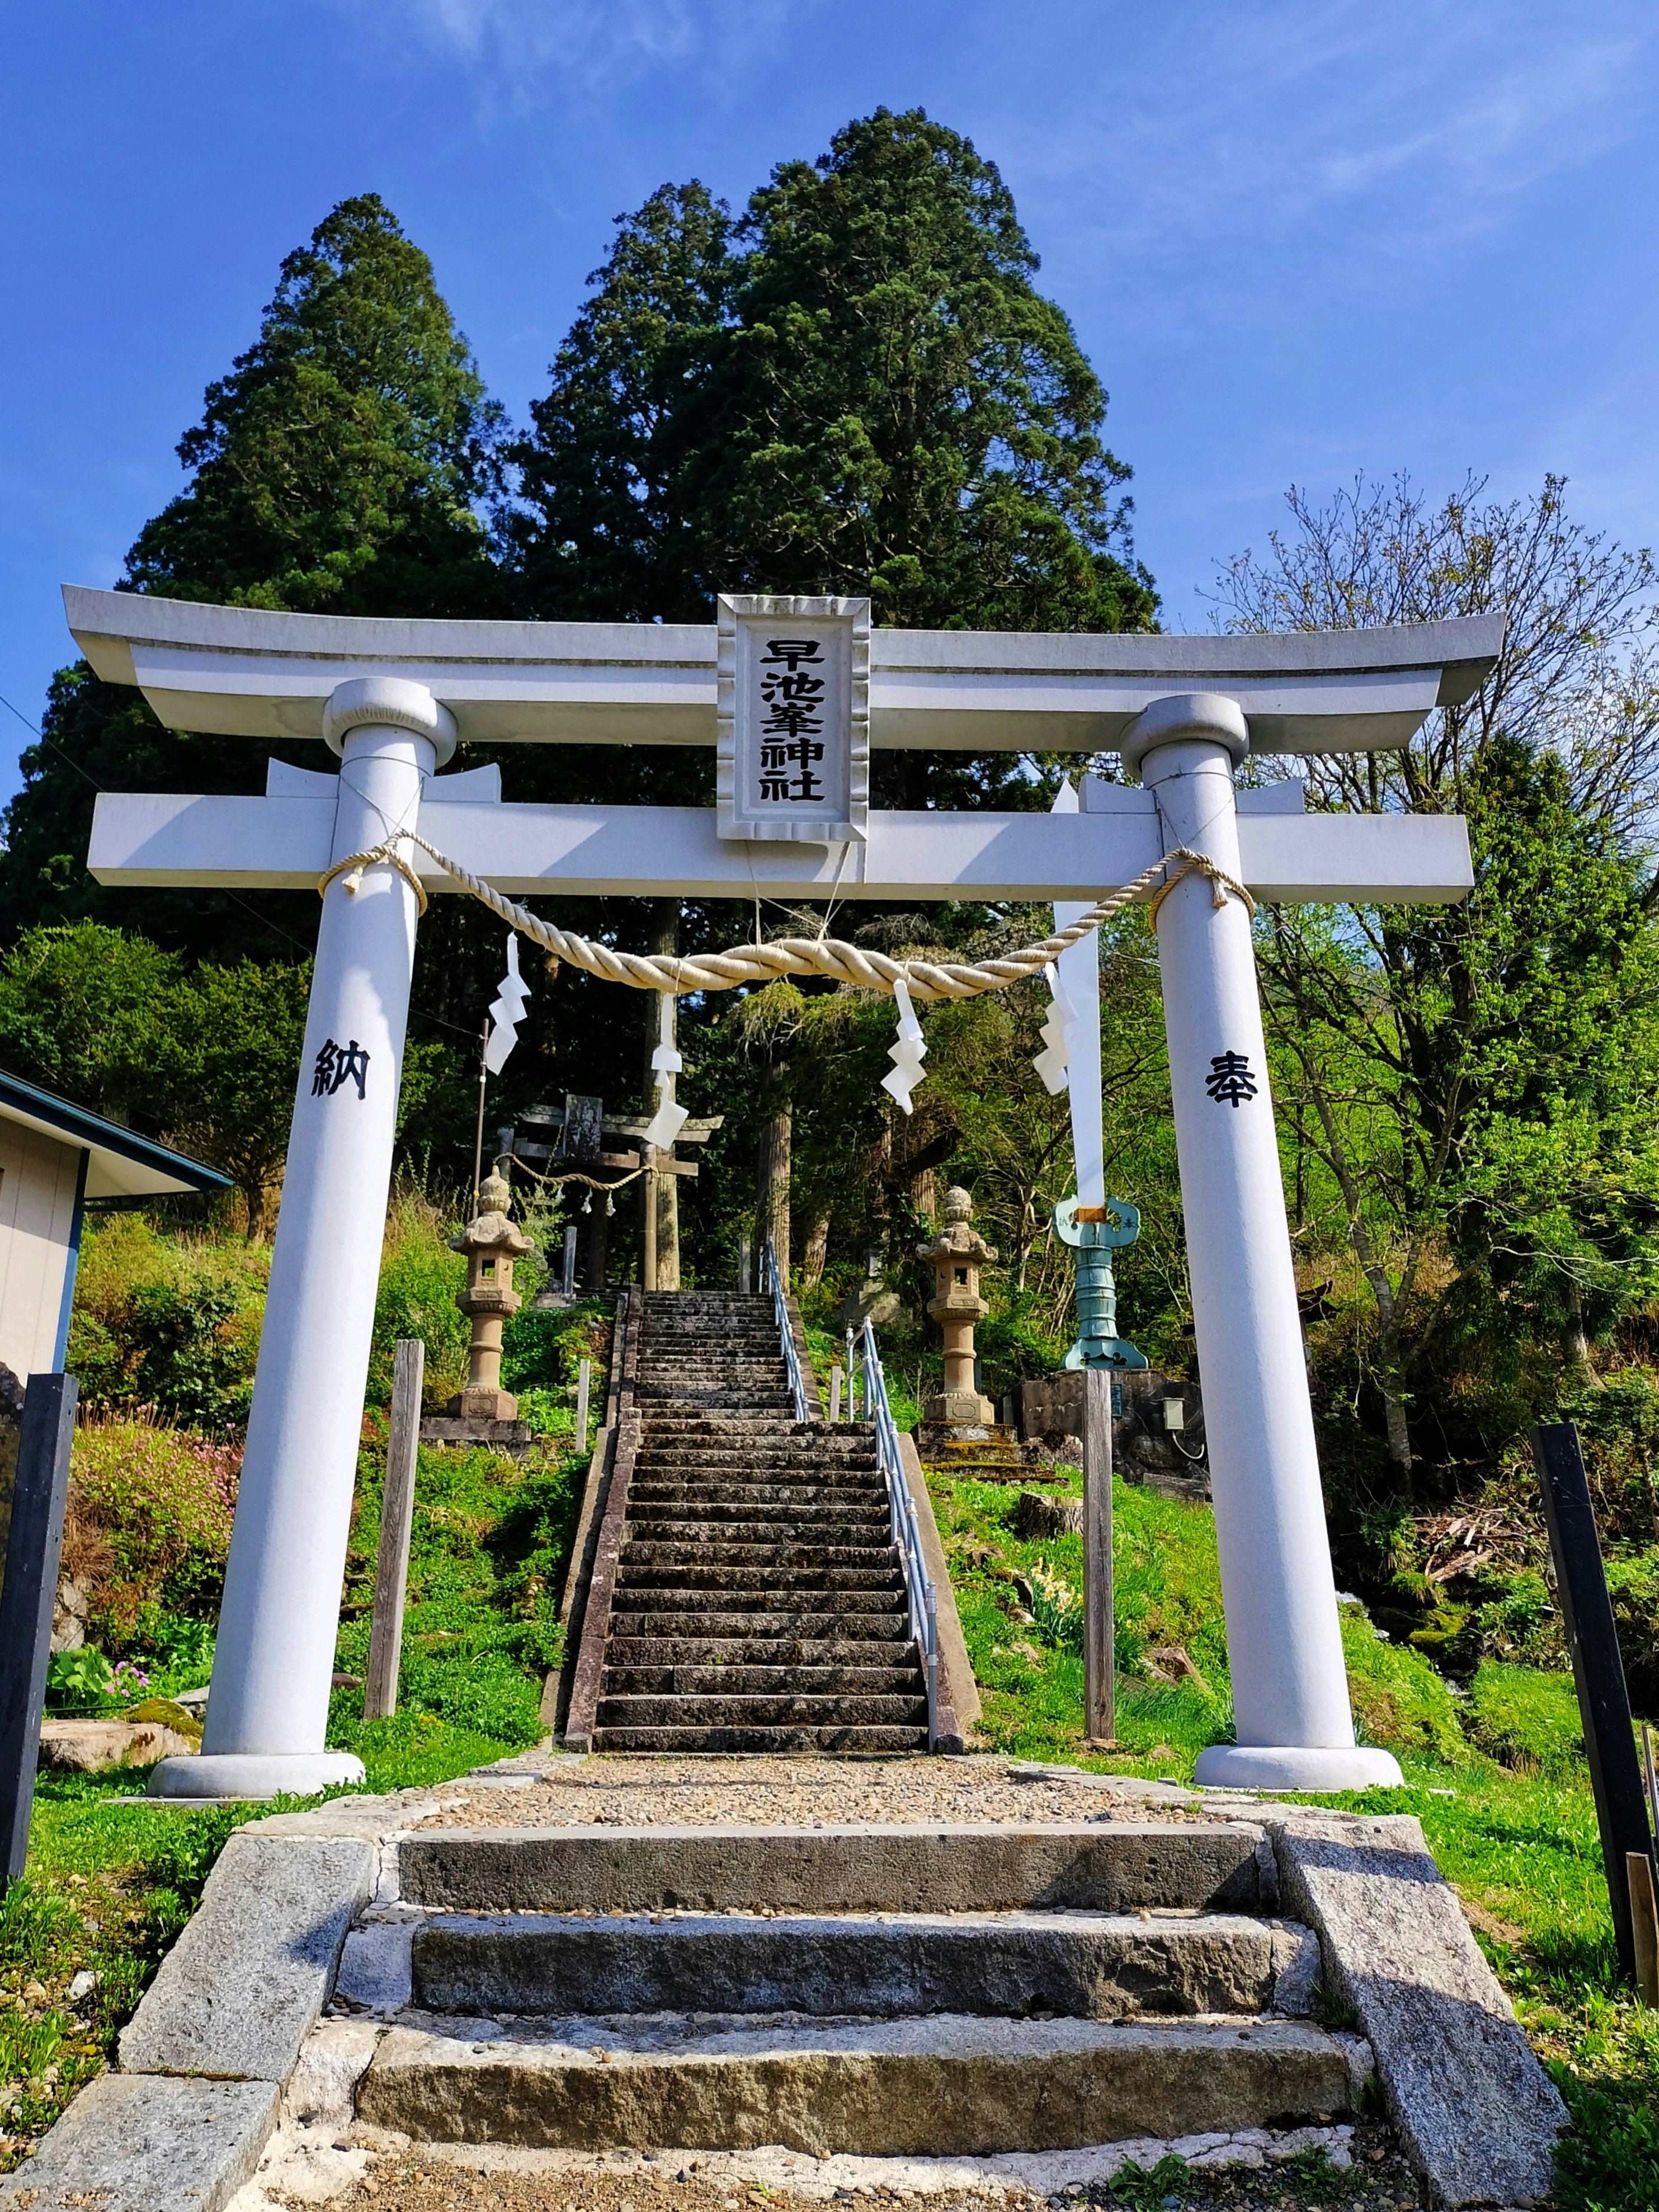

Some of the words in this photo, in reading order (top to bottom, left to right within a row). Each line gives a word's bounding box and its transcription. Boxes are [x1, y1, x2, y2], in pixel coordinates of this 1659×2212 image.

[758, 639, 825, 802] 早池峯神社
[311, 1039, 371, 1100] 納
[1205, 1050, 1258, 1107] 奉
